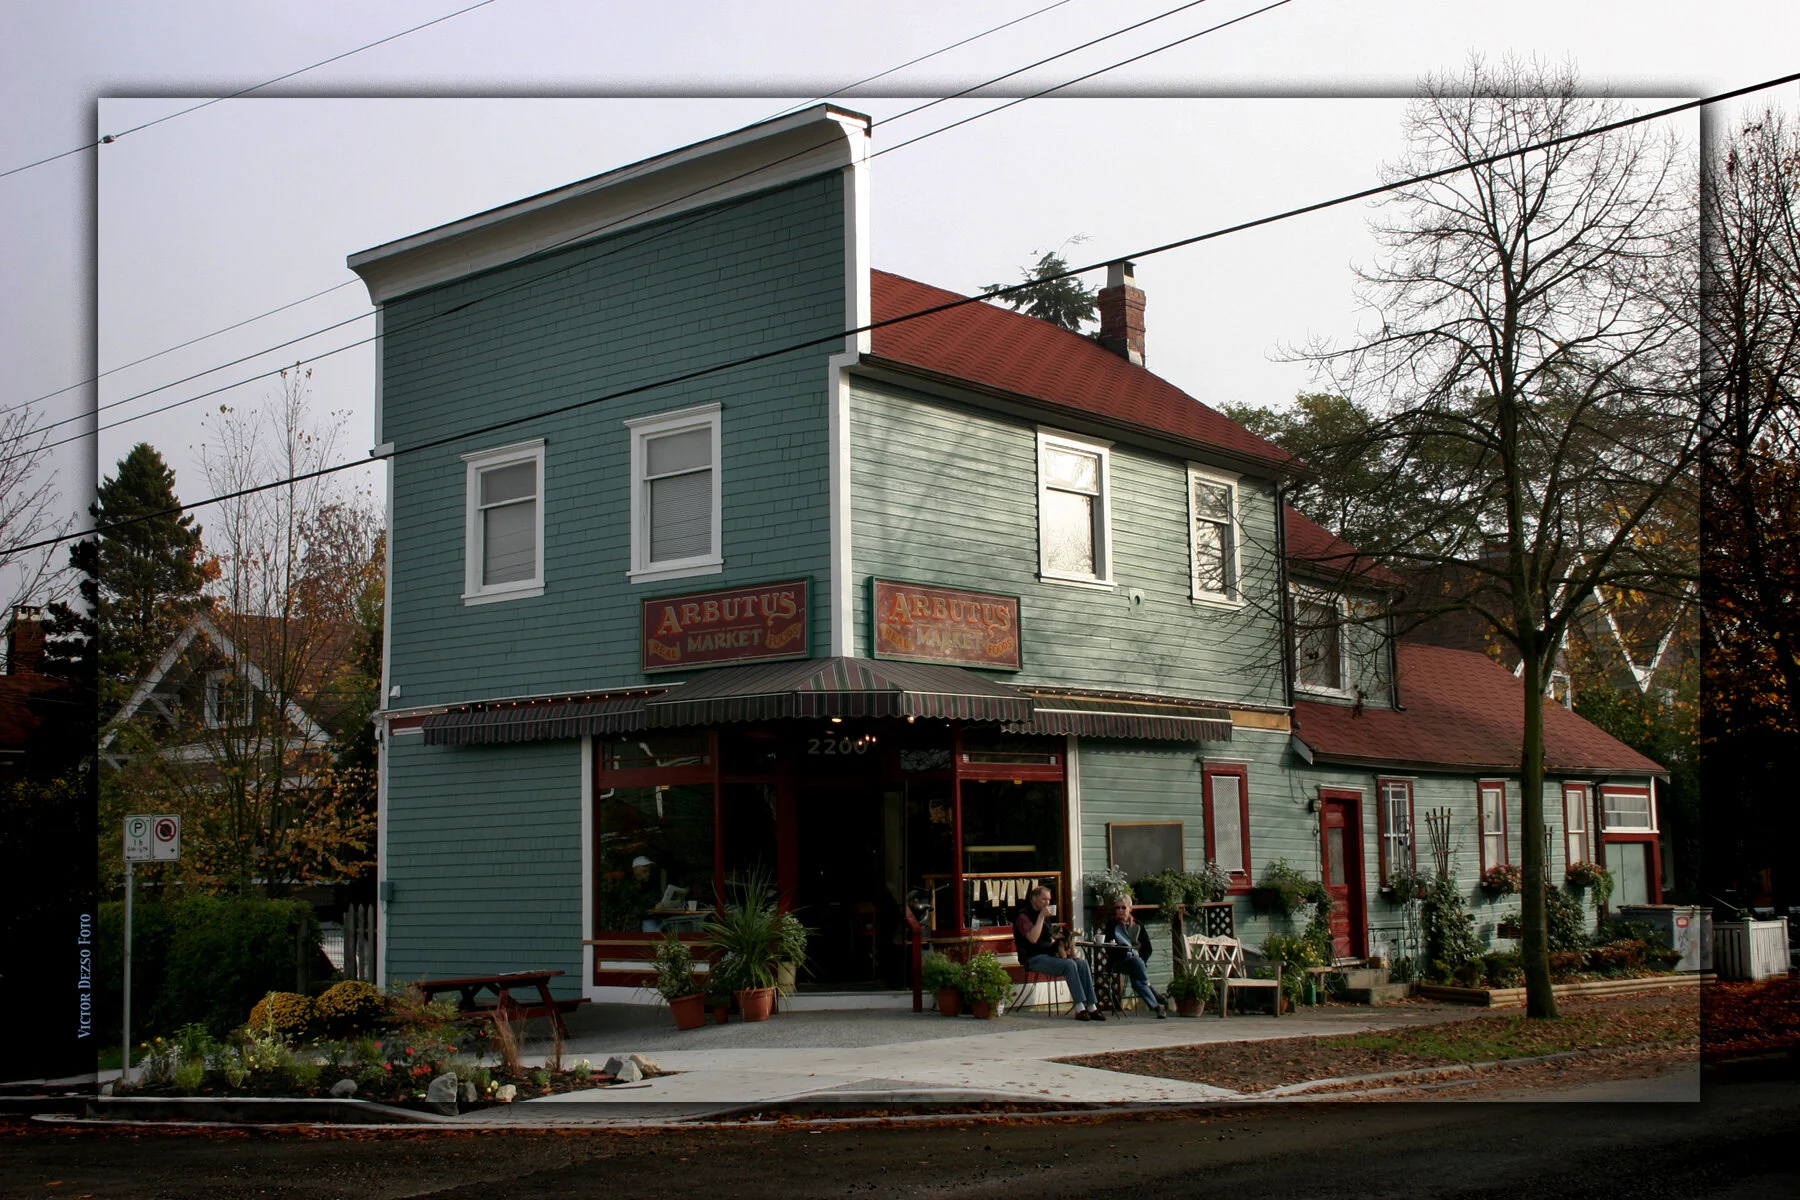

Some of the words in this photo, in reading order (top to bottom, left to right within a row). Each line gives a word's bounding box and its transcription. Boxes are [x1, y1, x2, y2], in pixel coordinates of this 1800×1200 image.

[655, 591, 797, 637] ARBUTUS
[886, 592, 1012, 638] ARBUTUS
[687, 629, 762, 653] MARKET
[768, 626, 800, 646] FOODS
[916, 627, 983, 651] MARKET
[653, 642, 678, 659] REAL
[987, 639, 1013, 656] FOODS
[807, 738, 868, 755] 2200
[134, 822, 143, 834] P
